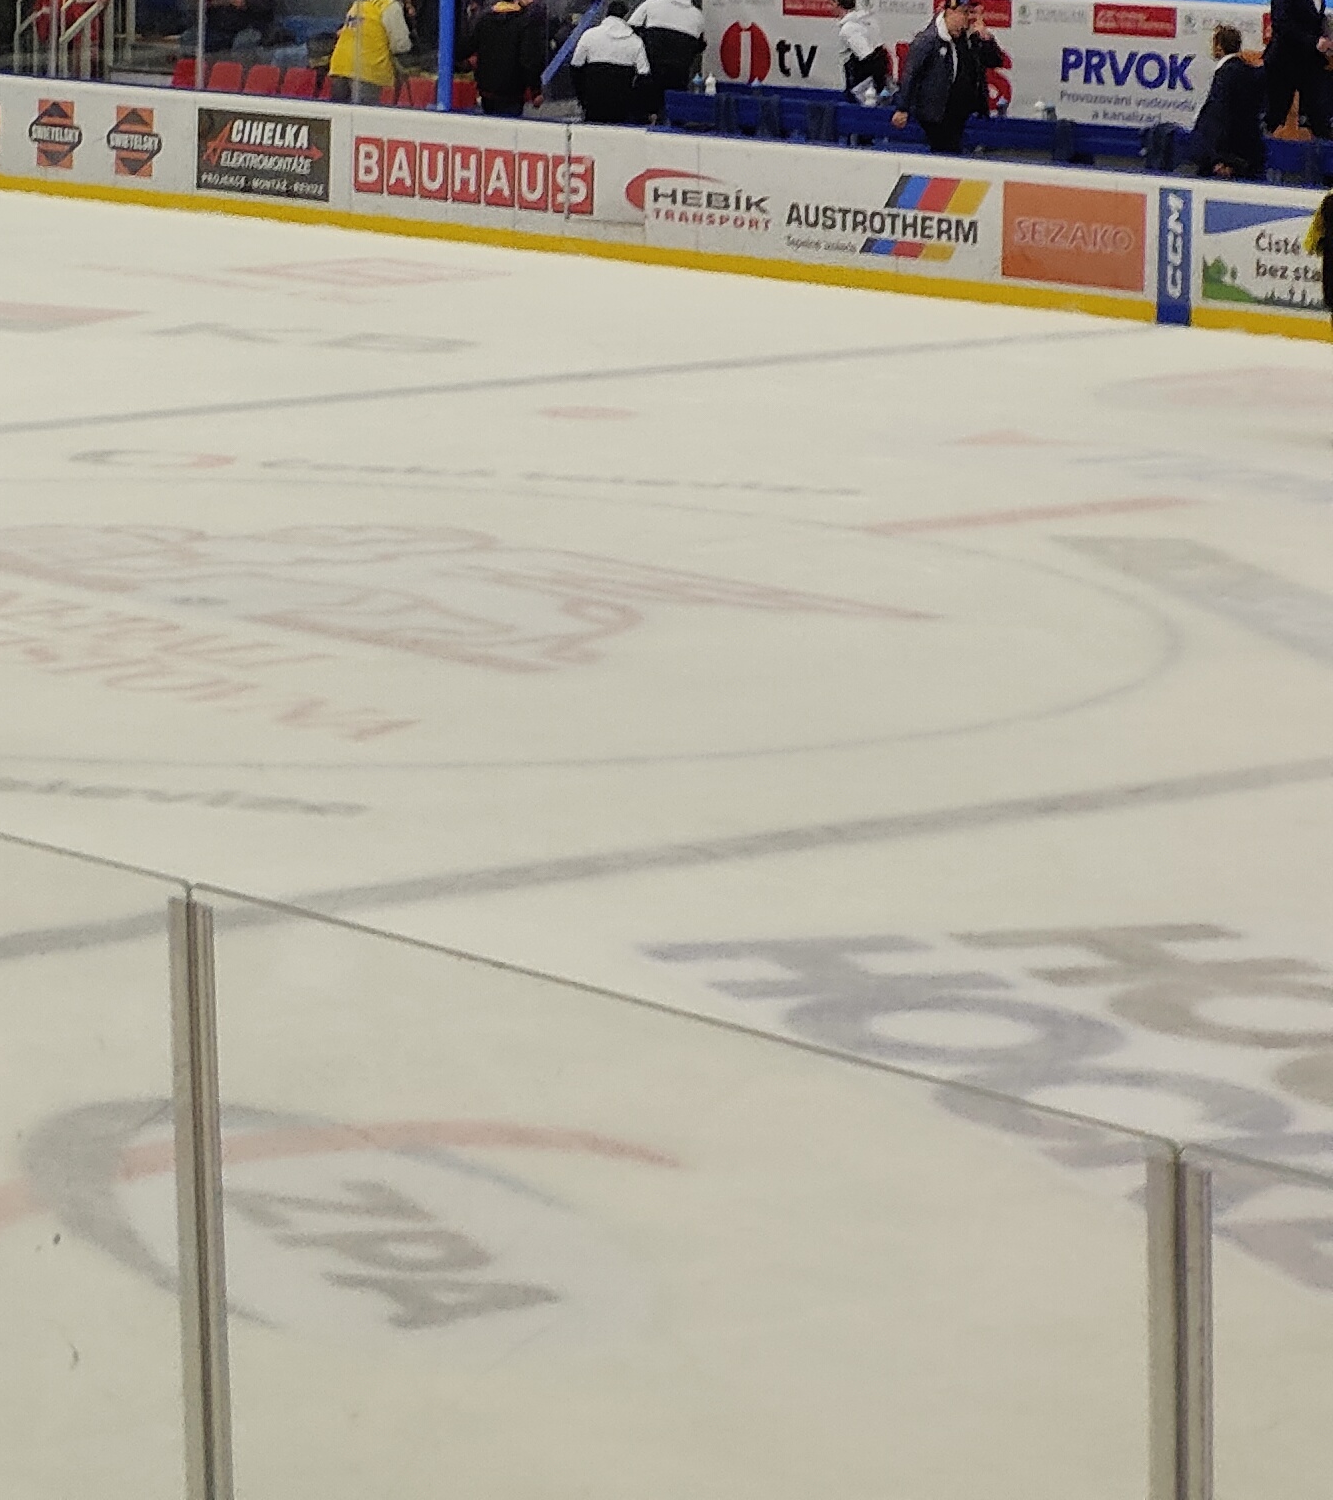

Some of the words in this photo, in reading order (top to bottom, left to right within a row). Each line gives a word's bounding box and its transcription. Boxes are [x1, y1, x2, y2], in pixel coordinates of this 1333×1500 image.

[1060, 46, 1197, 91] PRVOK
[230, 118, 310, 150] CIHELKA
[357, 140, 591, 213] BAUHAUS
[652, 185, 770, 214] HEBÍK
[652, 208, 773, 232] TRANSPORT
[785, 201, 979, 245] AUSTROTHERM
[1015, 217, 1132, 254] SEZAKO
[1255, 258, 1288, 280] bez
